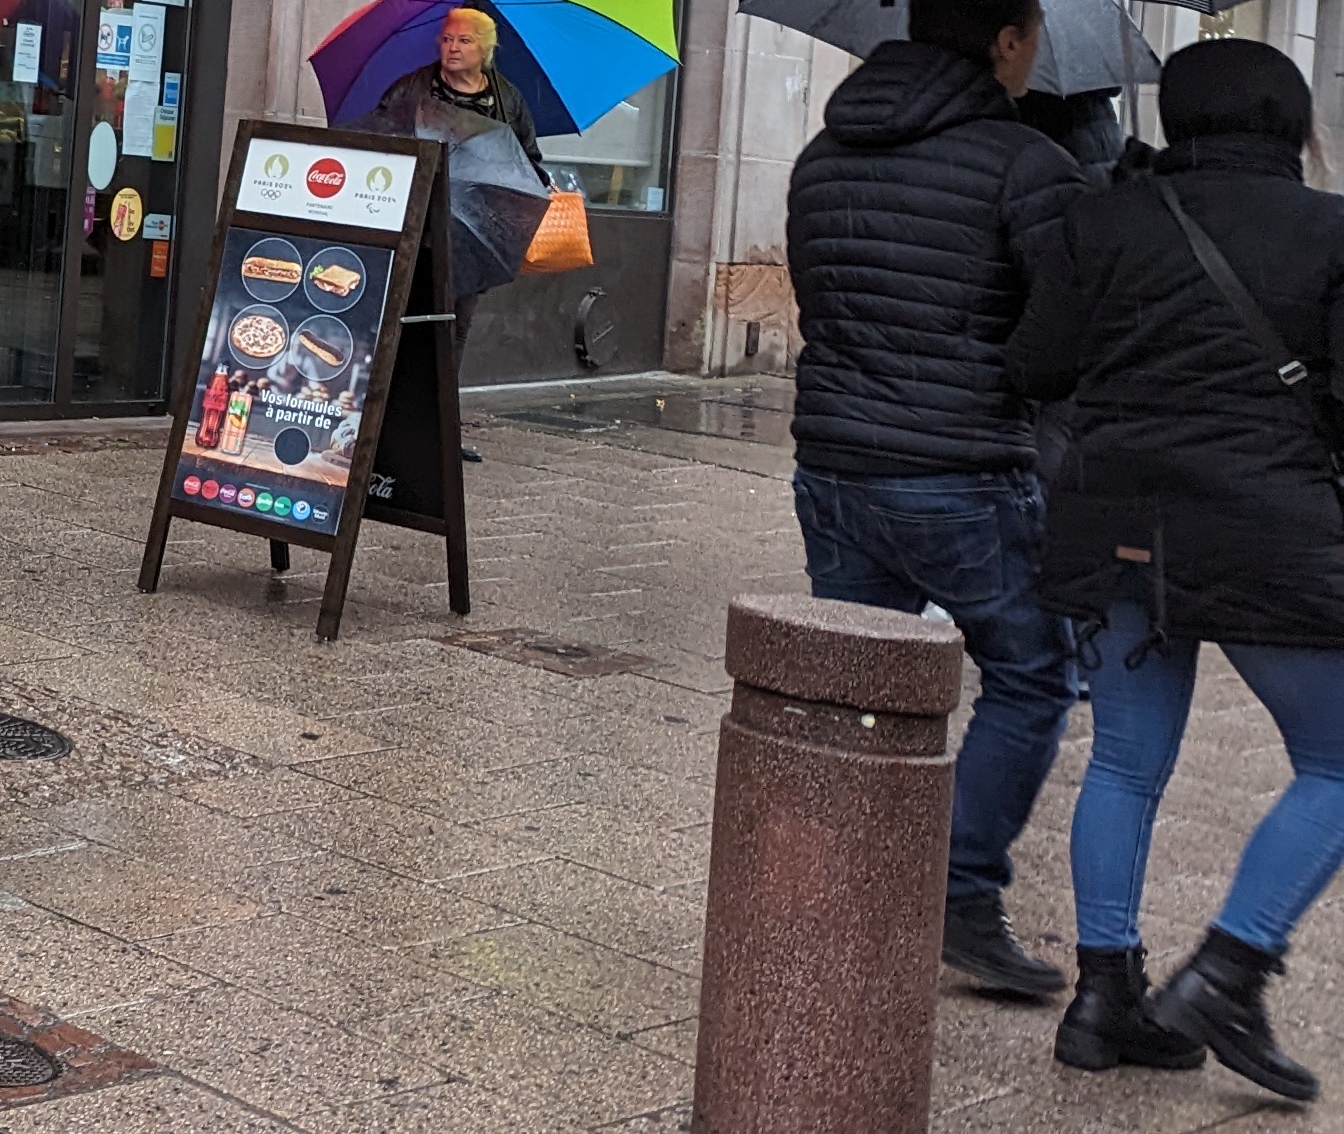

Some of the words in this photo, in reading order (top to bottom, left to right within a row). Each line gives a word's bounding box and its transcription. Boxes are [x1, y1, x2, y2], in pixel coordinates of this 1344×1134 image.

[253, 179, 274, 188] PARIS
[275, 182, 293, 191] 2024
[354, 192, 375, 201] PARIS
[377, 195, 397, 203] 2024
[261, 389, 283, 406] Vos
[286, 393, 343, 417] formules
[265, 404, 273, 418] à
[275, 408, 313, 426] partir
[315, 414, 331, 430] de
